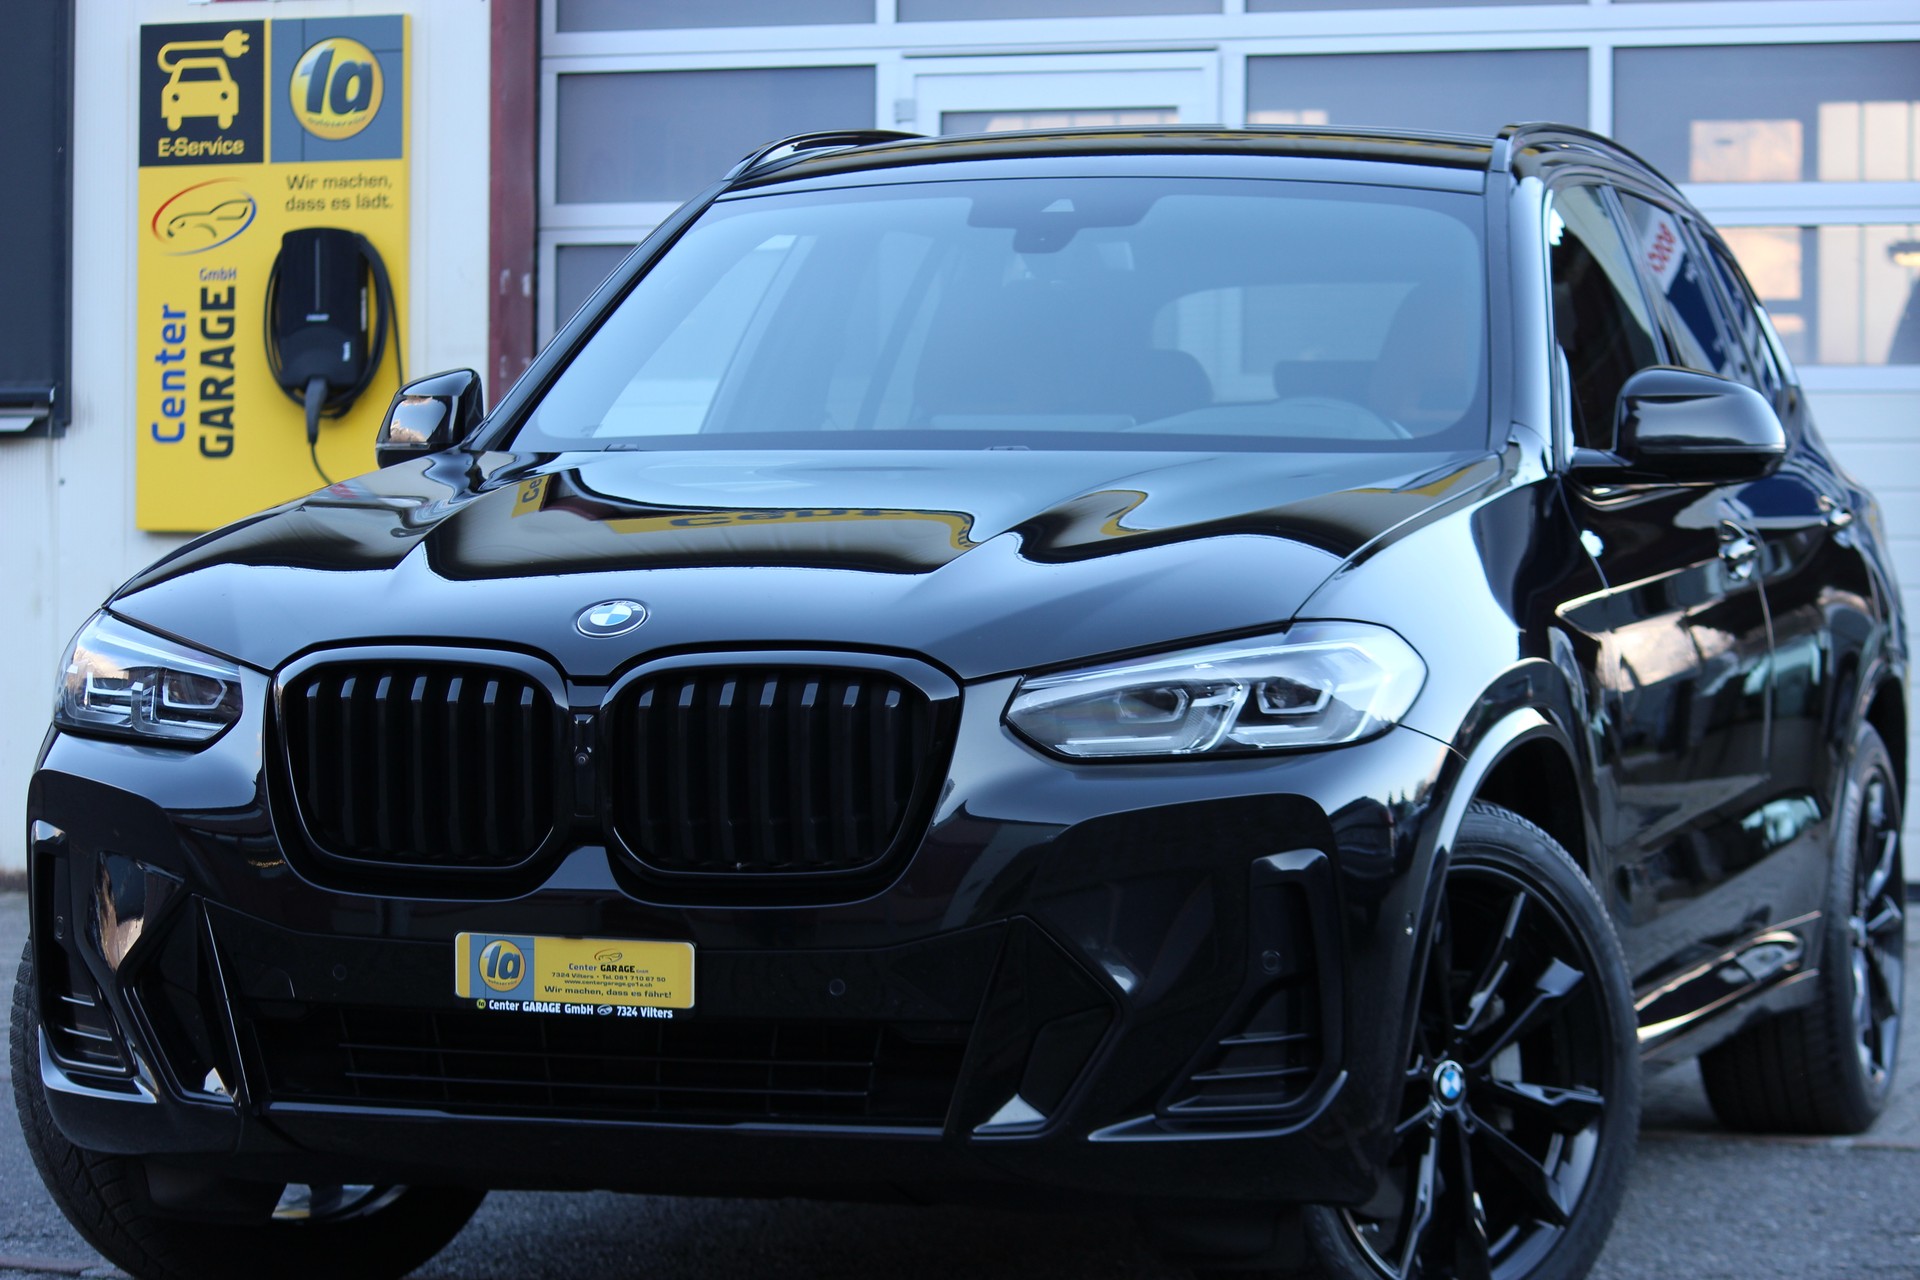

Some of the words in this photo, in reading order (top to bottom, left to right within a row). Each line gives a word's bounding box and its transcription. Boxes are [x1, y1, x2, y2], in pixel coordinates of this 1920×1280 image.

[299, 47, 374, 116] 1a
[158, 135, 245, 158] E-Service
[286, 174, 319, 190] Wir
[322, 172, 392, 190] machen,
[285, 196, 326, 211] dass
[331, 198, 351, 211] es
[199, 267, 237, 281] GmbH
[152, 304, 187, 443] Center
[199, 286, 236, 459] GARAGE
[484, 945, 521, 980] 1a
[568, 963, 597, 972] Center
[600, 964, 636, 973] GARAGE
[565, 988, 604, 996] machen,
[489, 1000, 519, 1011] Center
[522, 1001, 561, 1013] GARAGE
[564, 1003, 594, 1015] GmbH
[617, 1006, 638, 1017] 7324
[640, 1006, 673, 1018] Vilters
